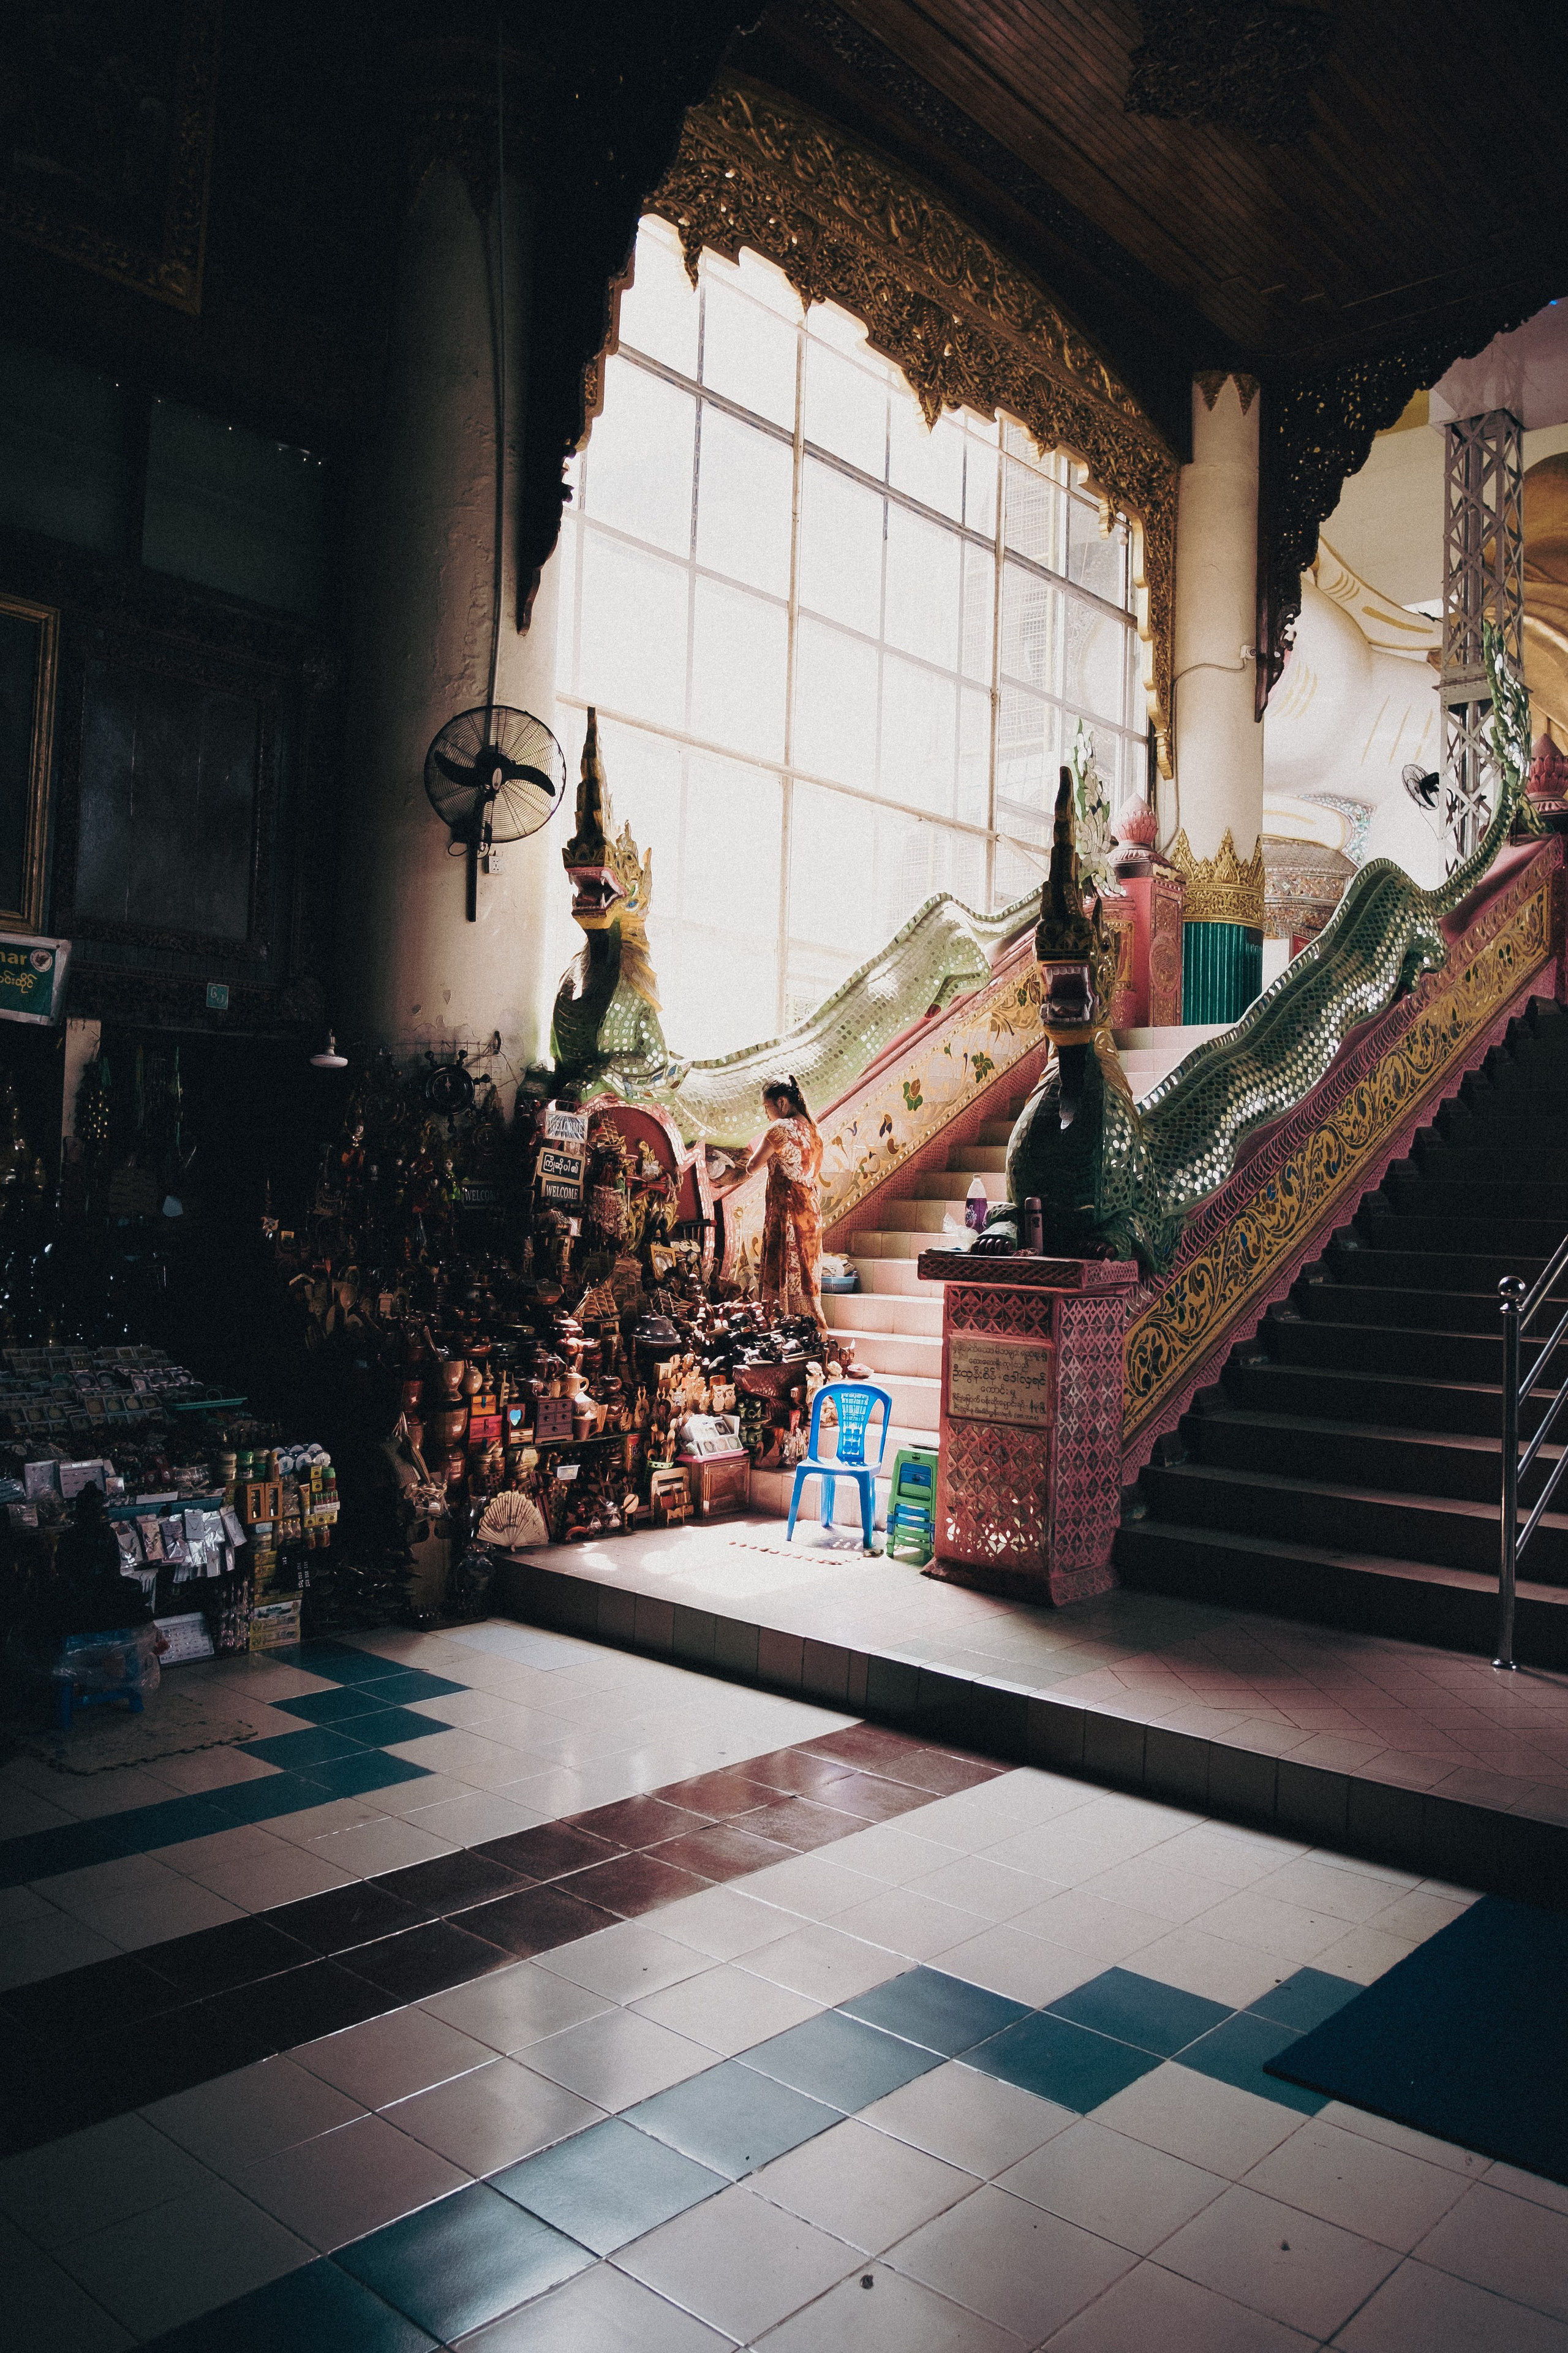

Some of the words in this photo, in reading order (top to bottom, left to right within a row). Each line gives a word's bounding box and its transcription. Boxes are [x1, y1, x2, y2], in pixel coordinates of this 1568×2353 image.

[549, 1119, 584, 1134] WELCOME
[464, 1188, 496, 1201] WELCO
[546, 1185, 578, 1199] WELCOME
